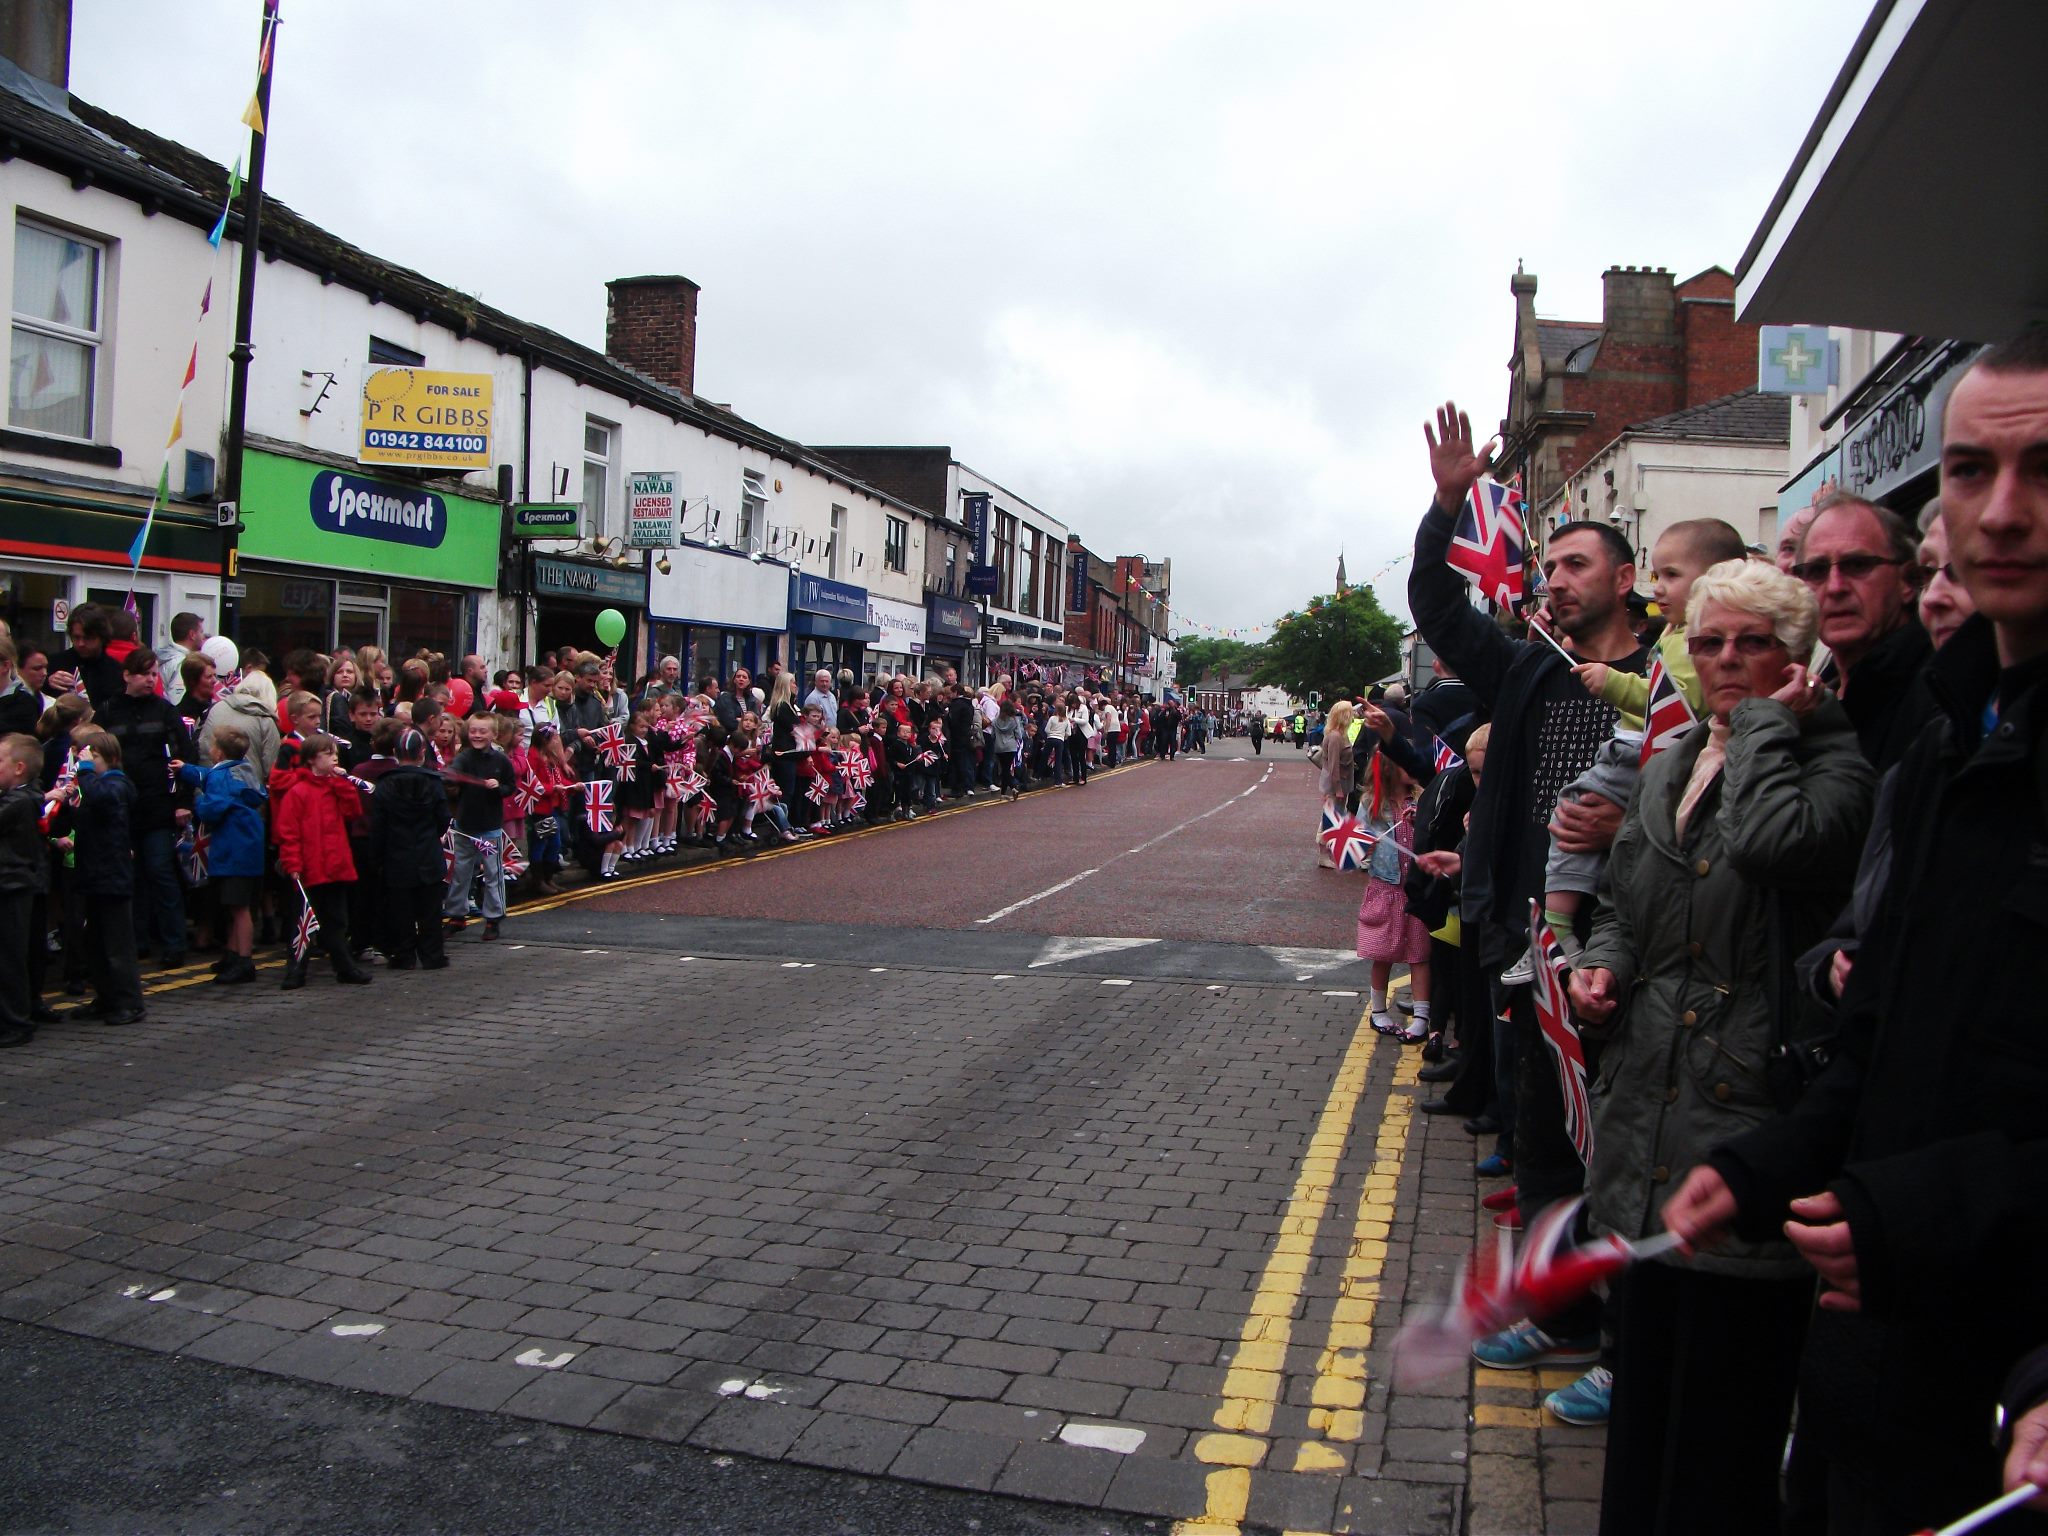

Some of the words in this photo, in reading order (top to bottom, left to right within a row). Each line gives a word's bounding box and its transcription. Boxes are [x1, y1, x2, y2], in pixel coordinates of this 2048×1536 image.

[426, 385, 449, 396] FOR
[452, 386, 480, 397] SALE
[368, 403, 382, 421] P
[393, 404, 407, 423] R
[416, 406, 489, 428] GIBBS
[369, 431, 419, 448] 01942
[423, 434, 483, 451] 844100
[378, 451, 473, 462] www.prgibbs.co.uk
[633, 481, 673, 494] NAWAB
[328, 475, 434, 531] Spexmart
[635, 497, 671, 507] LICENSED
[523, 512, 570, 525] Spexmart
[632, 507, 672, 518] RESTAURANT
[633, 521, 672, 529] TAKEAWAY
[633, 529, 671, 538] AVAILABLE
[540, 565, 562, 585] THE
[875, 612, 883, 627] The
[904, 618, 920, 637] Society
